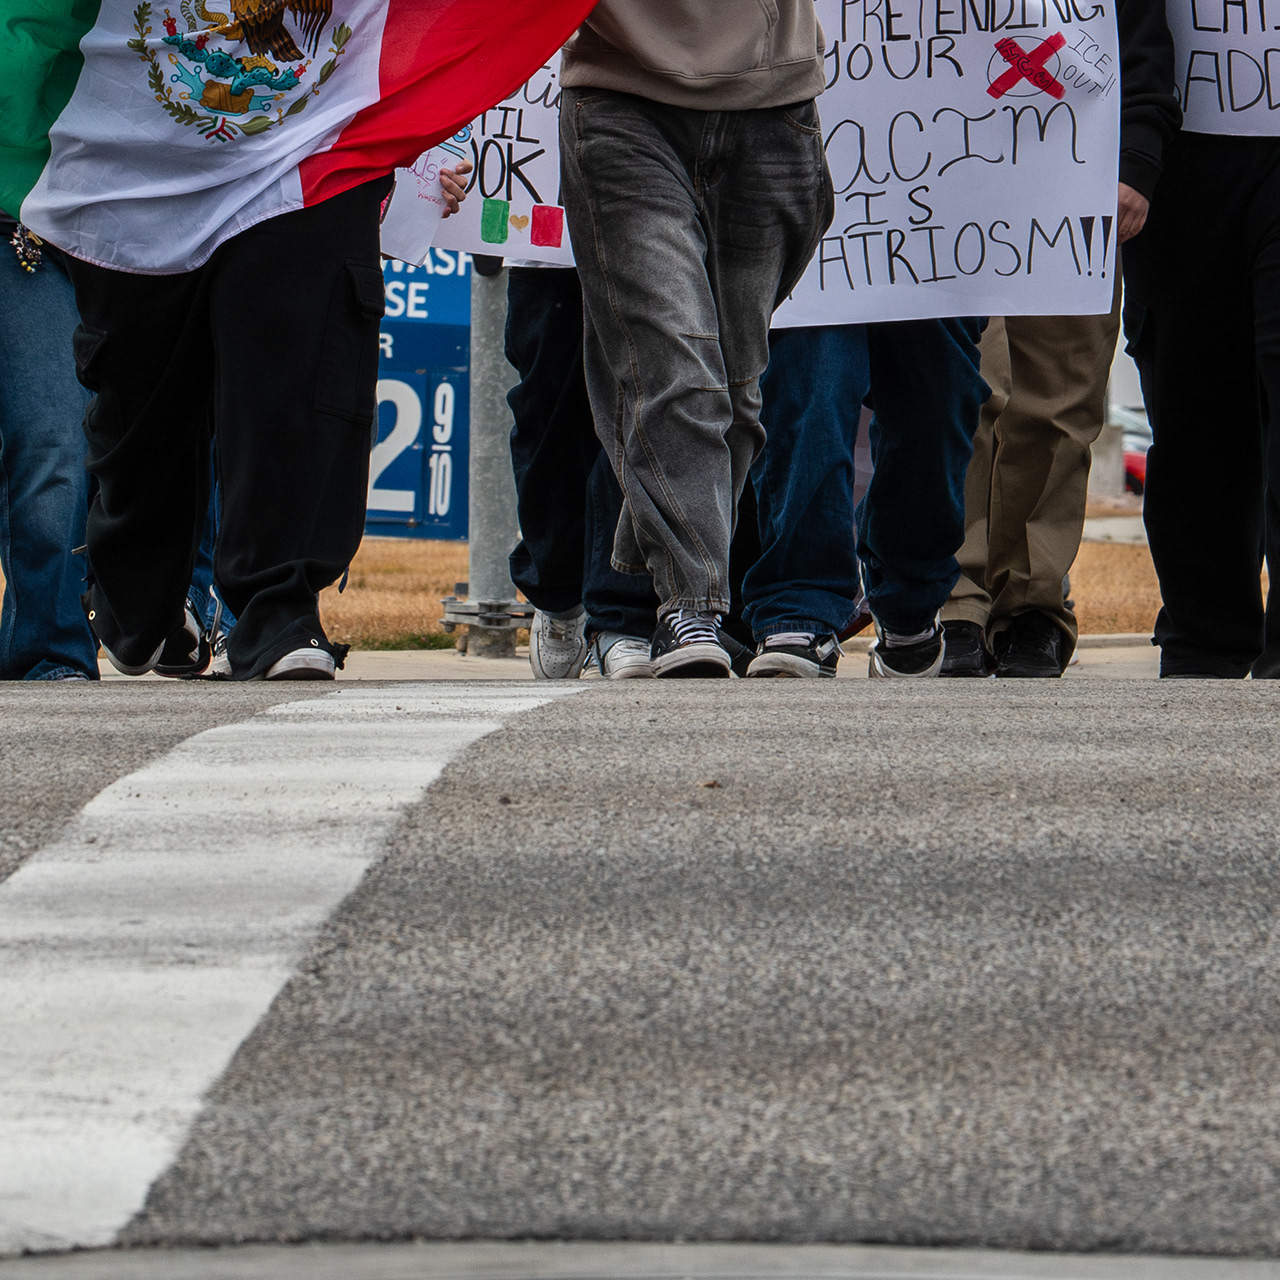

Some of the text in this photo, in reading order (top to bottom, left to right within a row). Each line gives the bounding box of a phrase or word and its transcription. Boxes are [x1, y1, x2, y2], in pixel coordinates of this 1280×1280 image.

[1067, 28, 1113, 75] ICE
[844, 185, 933, 235] IS
[819, 215, 1114, 291] ATRIOSM!!
